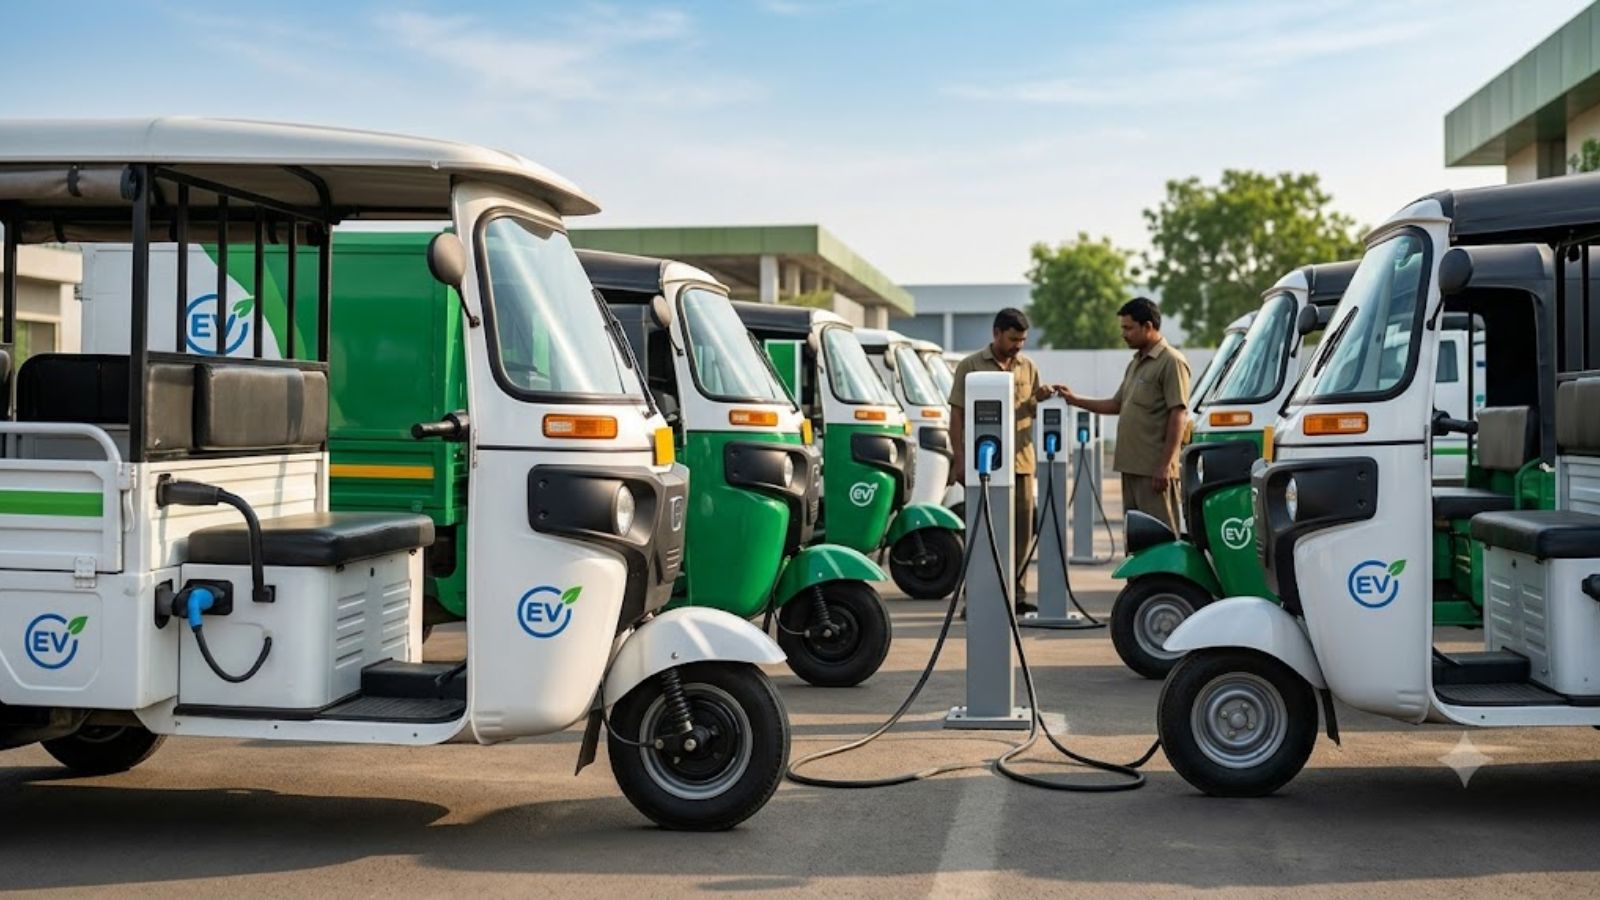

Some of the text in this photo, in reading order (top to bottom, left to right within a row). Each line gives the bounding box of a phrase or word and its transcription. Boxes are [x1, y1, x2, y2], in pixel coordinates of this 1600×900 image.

[1226, 527, 1246, 541] EV
[1357, 574, 1391, 594] EV
[527, 602, 563, 623] EV
[33, 630, 70, 653] EV
